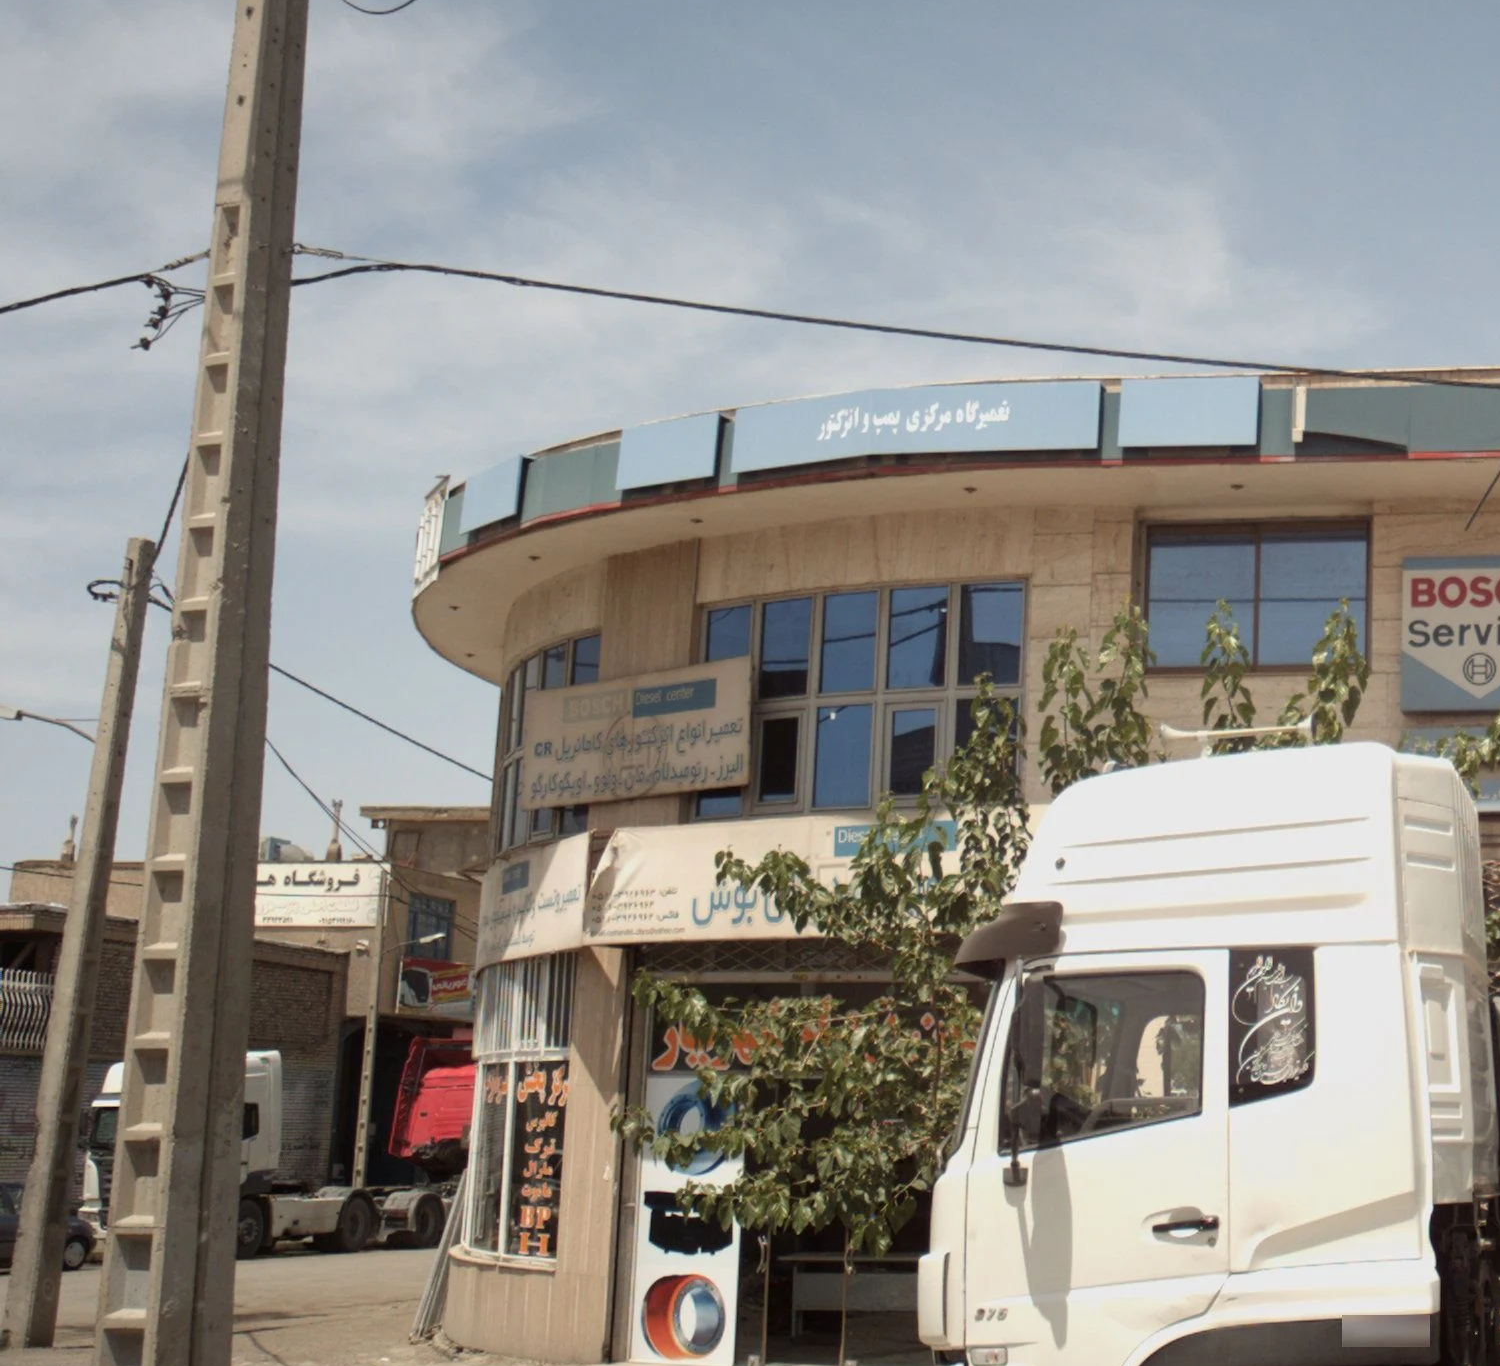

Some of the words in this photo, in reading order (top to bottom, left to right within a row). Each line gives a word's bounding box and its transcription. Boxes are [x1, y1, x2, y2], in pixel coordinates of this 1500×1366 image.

[816, 406, 861, 441] انژکتور
[860, 411, 870, 434] و
[872, 409, 901, 436] پمپ
[905, 401, 952, 433] مرکزی
[955, 400, 1011, 430] تعمیرگاه
[533, 741, 553, 757] CR
[284, 868, 361, 893] فروشگاه
[519, 1205, 551, 1229] BP
